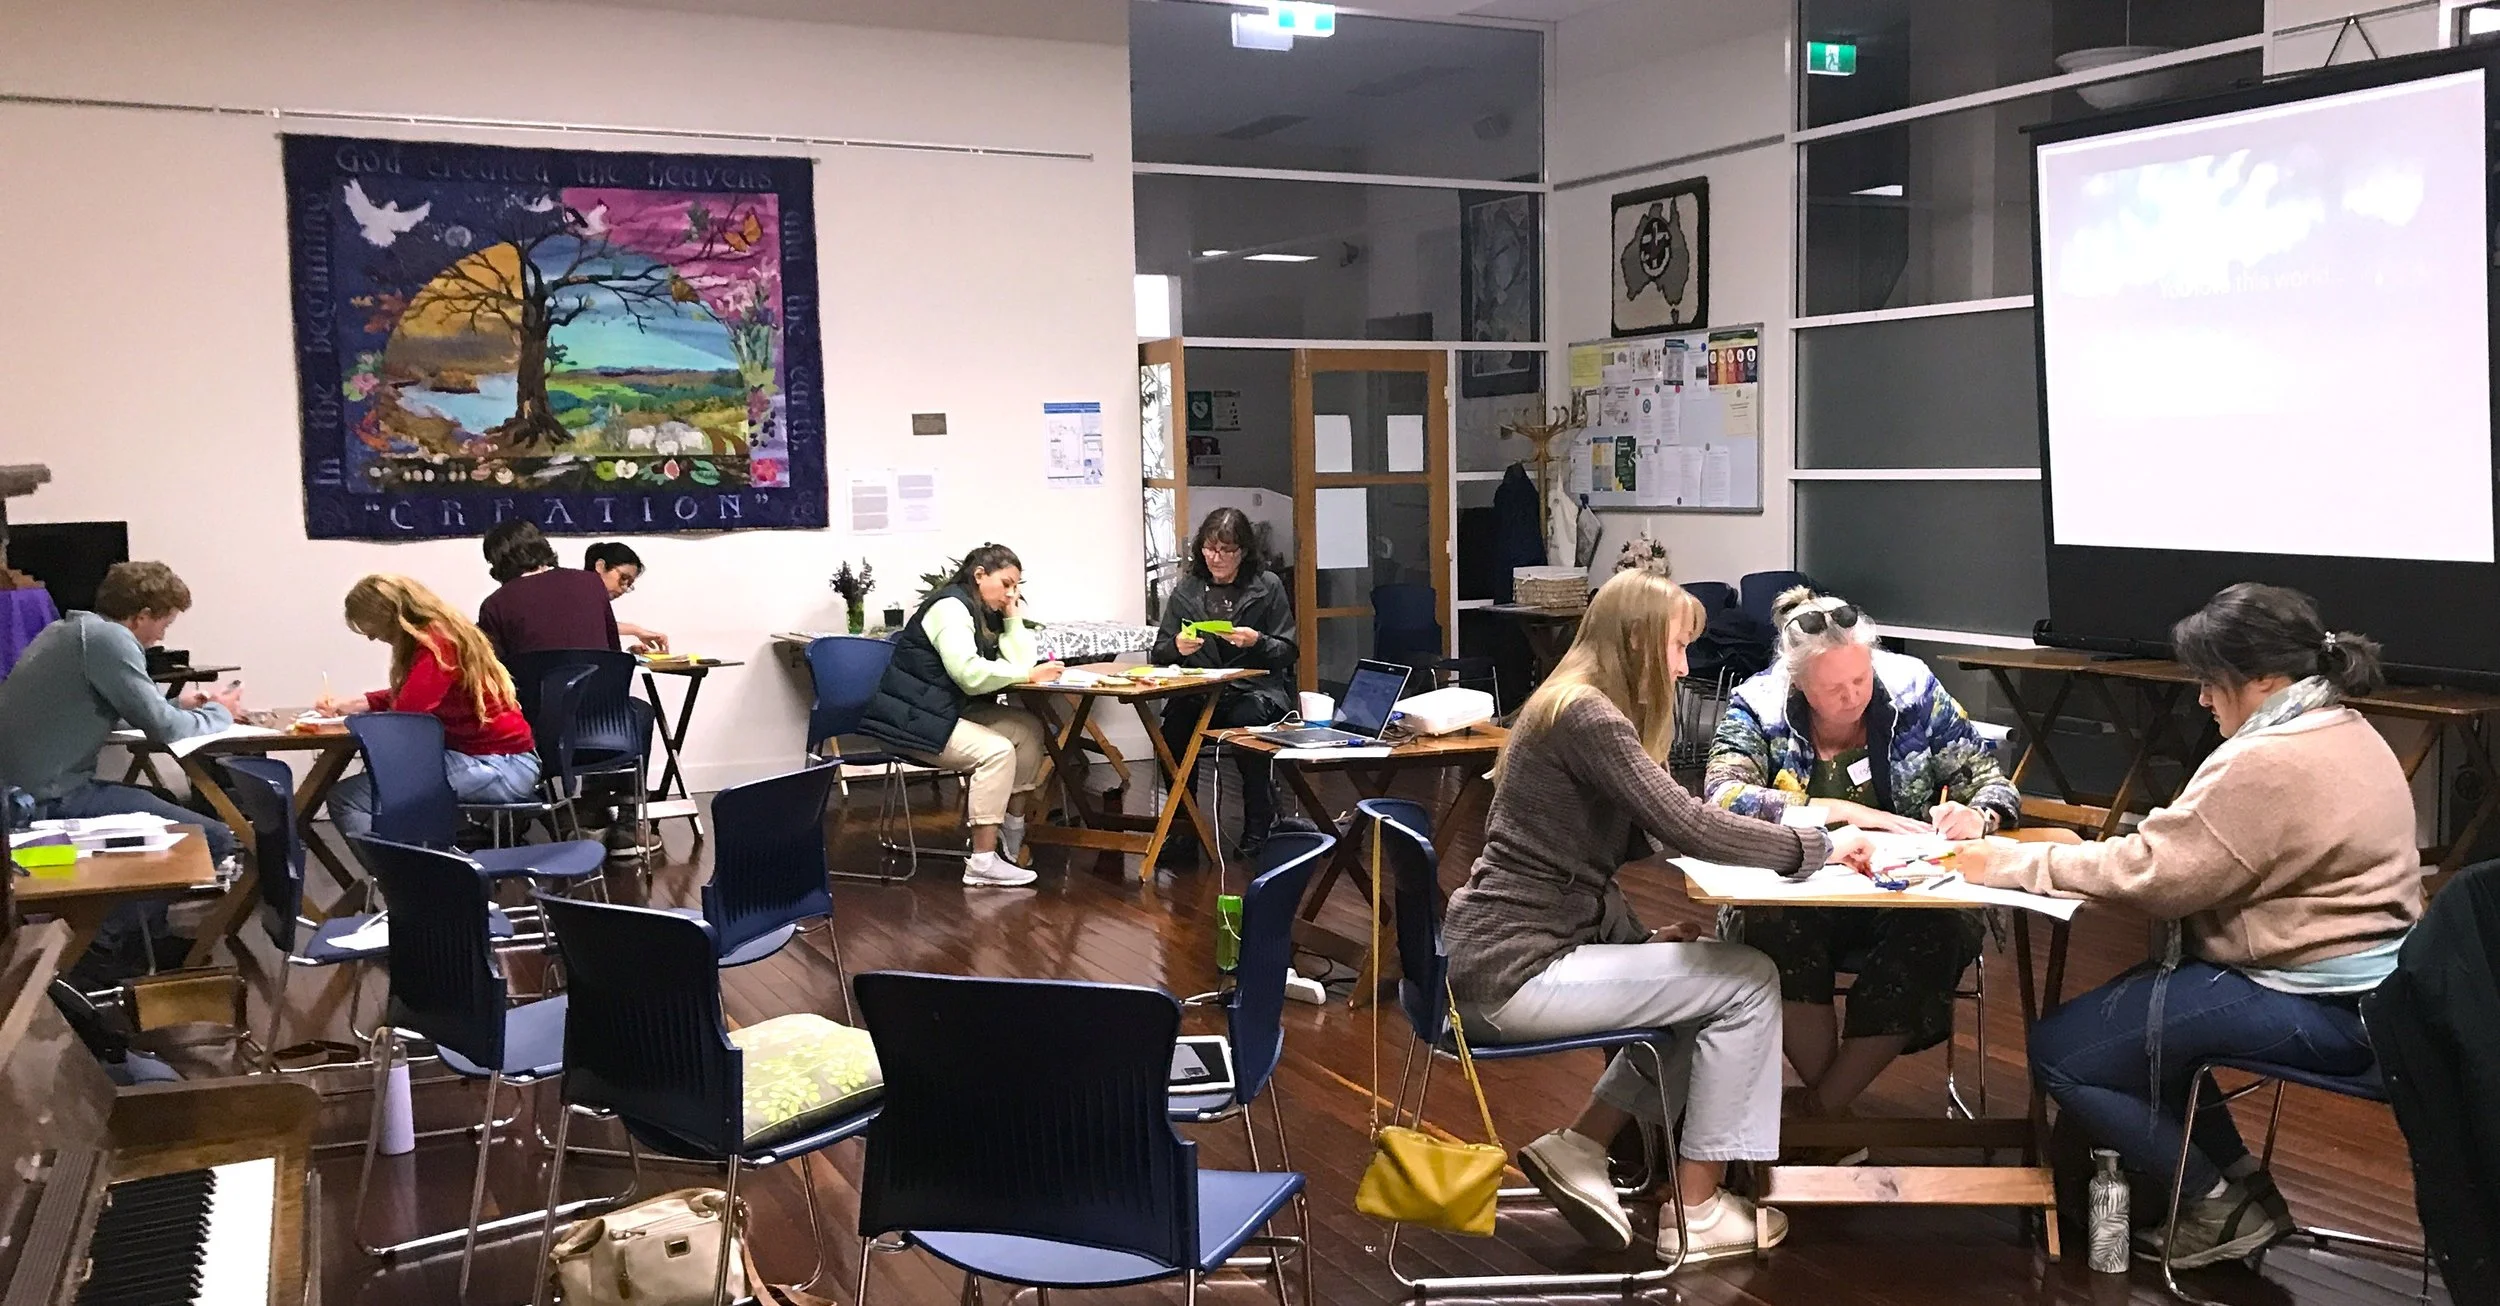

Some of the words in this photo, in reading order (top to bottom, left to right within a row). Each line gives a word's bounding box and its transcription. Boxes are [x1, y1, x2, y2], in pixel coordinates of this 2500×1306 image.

[335, 144, 401, 174] God
[576, 157, 622, 185] the
[648, 160, 773, 189] heavens
[308, 383, 340, 429] the
[313, 458, 342, 485] In
